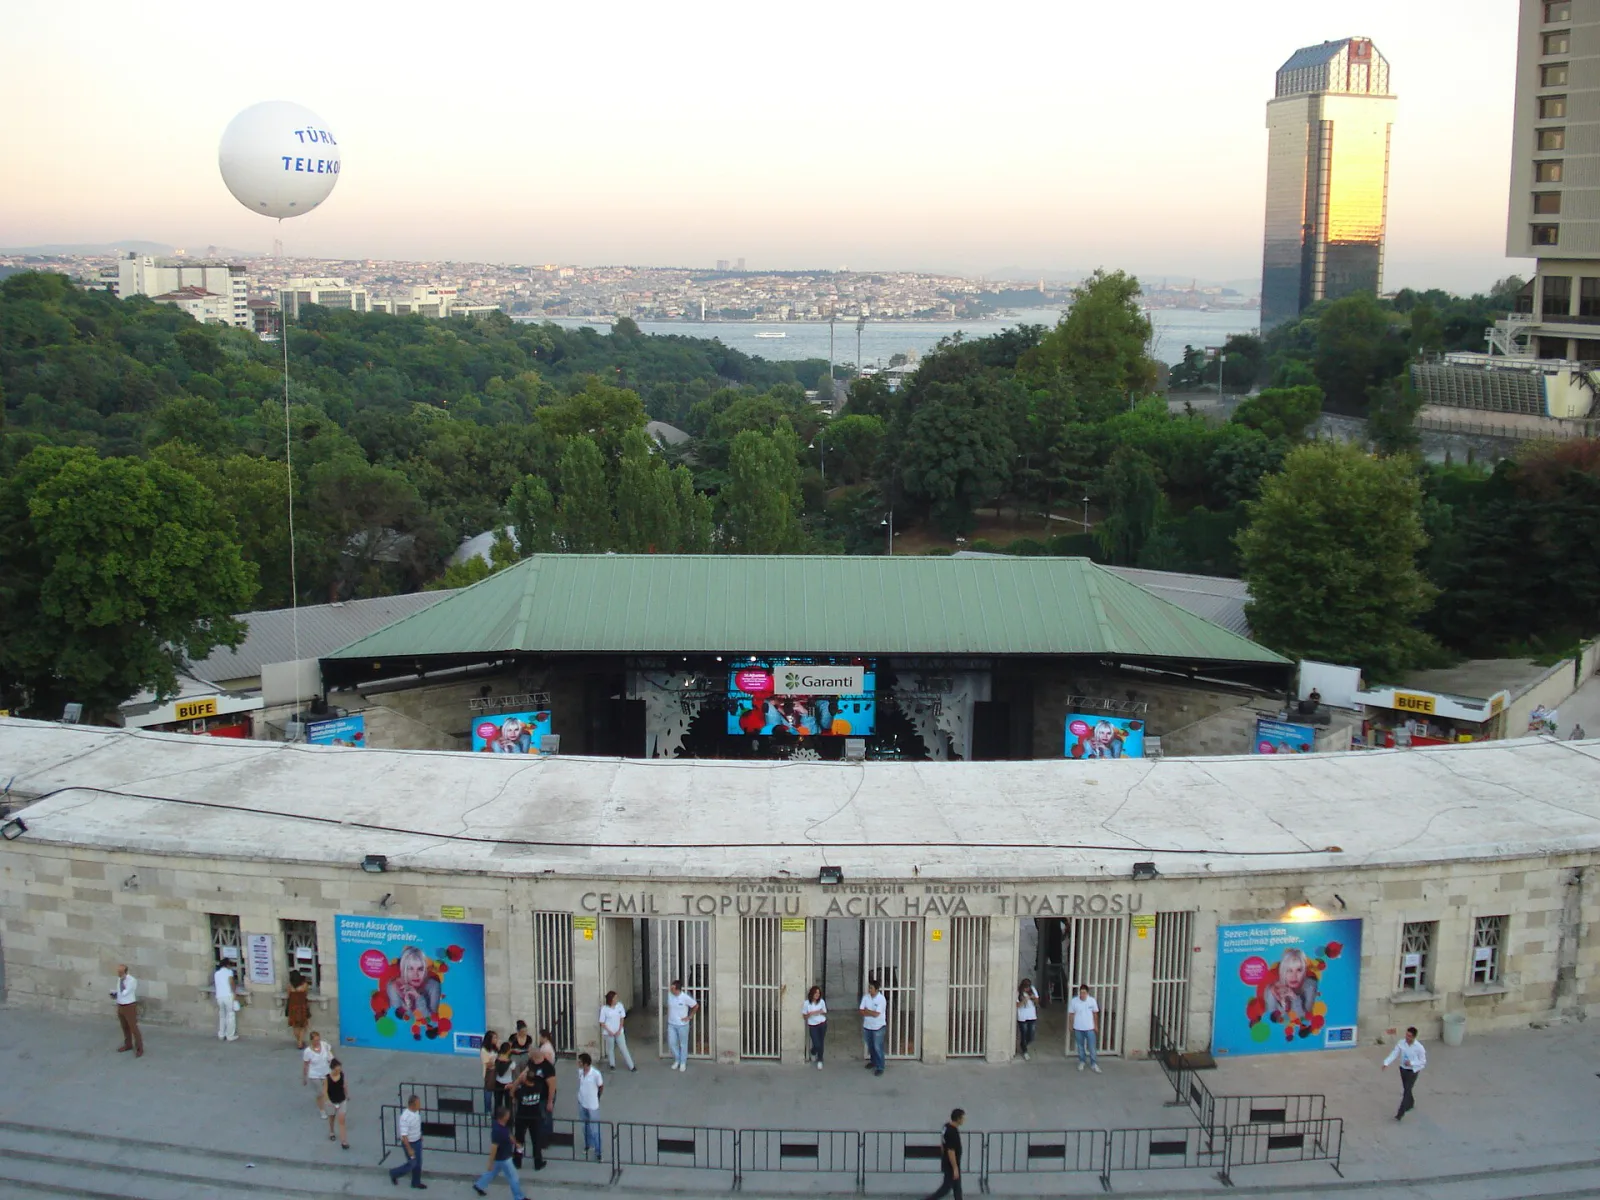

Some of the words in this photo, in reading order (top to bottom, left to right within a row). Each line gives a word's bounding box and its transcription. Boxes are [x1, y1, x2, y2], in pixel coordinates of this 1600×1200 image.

[295, 126, 337, 145] TÜRK
[282, 156, 340, 174] TELEKO
[802, 676, 853, 687] Garanti
[179, 703, 213, 718] BÜFE
[1398, 694, 1432, 711] BÜFE
[581, 891, 659, 914] CEMİL
[682, 894, 800, 916] TOPUZLU
[904, 896, 971, 916] HAVA
[997, 892, 1143, 916] TİYATROSU
[341, 920, 365, 929] Sezen
